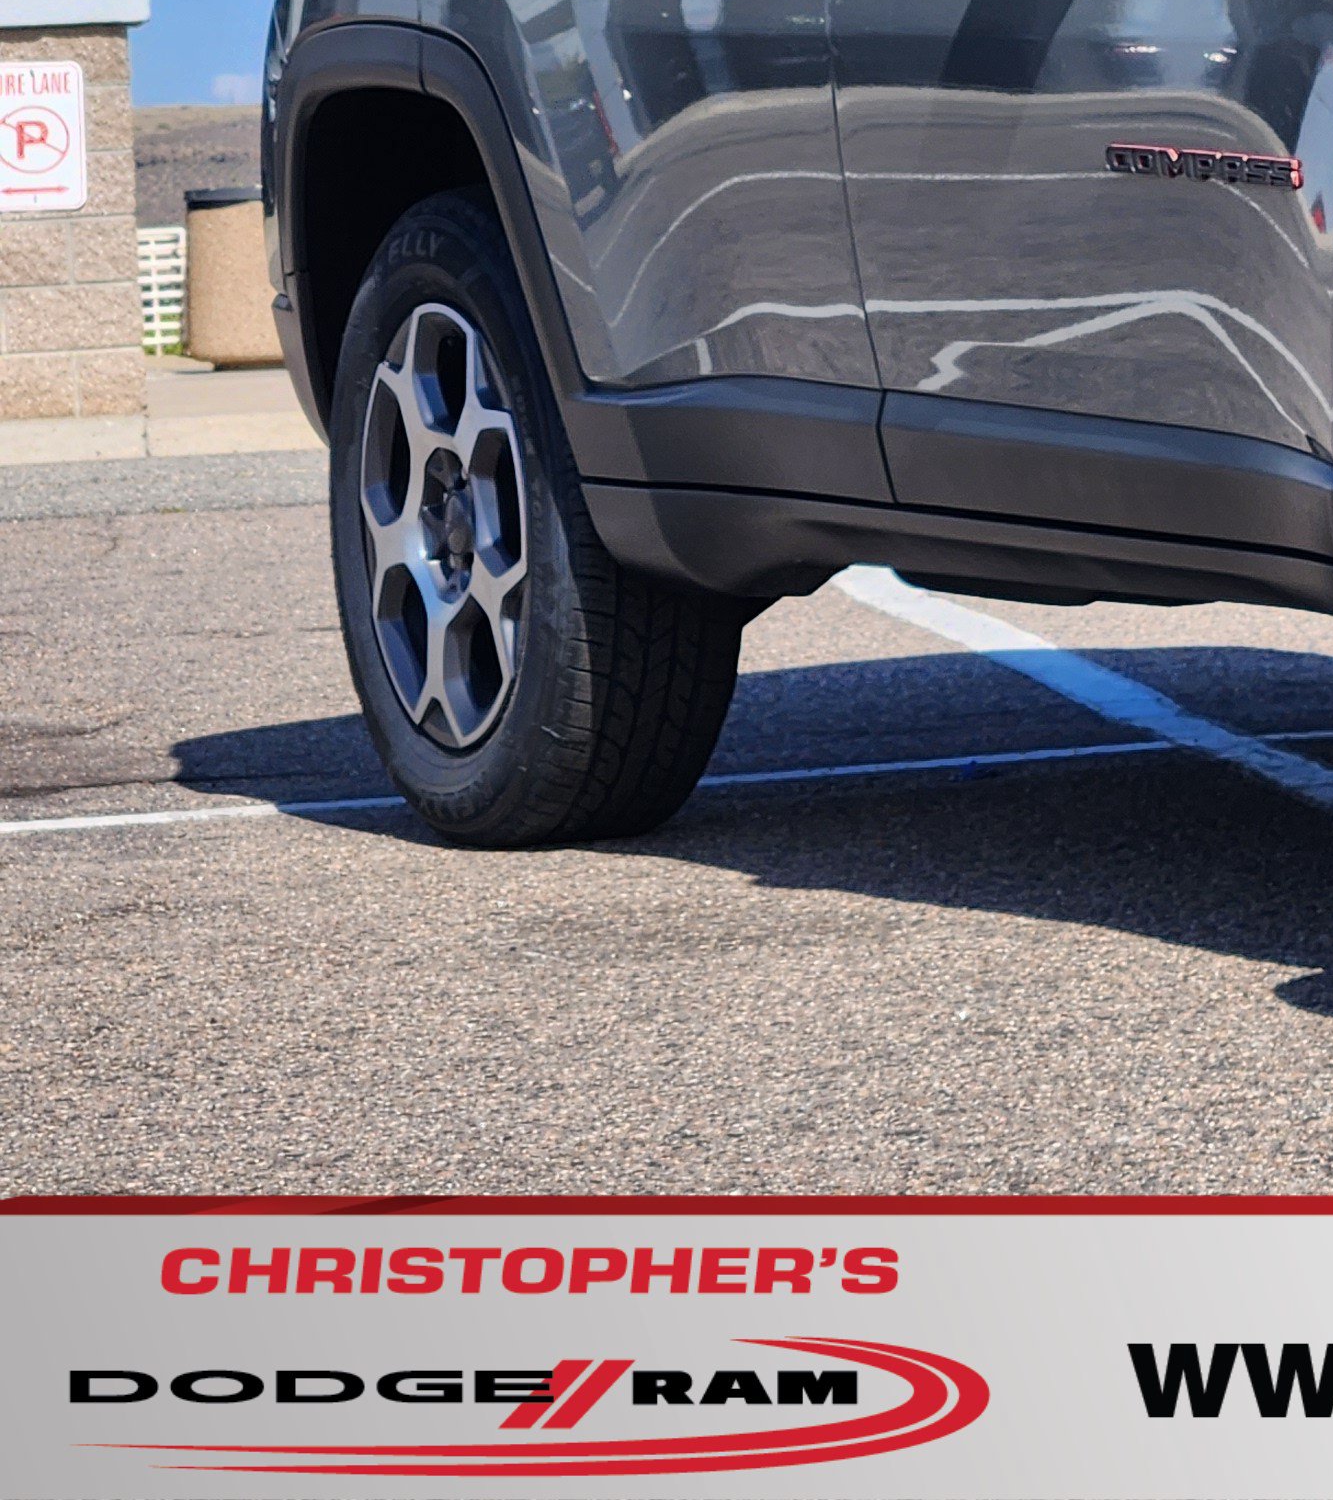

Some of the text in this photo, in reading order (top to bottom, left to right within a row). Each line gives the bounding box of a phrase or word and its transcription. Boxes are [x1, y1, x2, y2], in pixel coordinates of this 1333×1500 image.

[0, 69, 72, 97] IRE LANE
[1104, 142, 1304, 189] COMPASS
